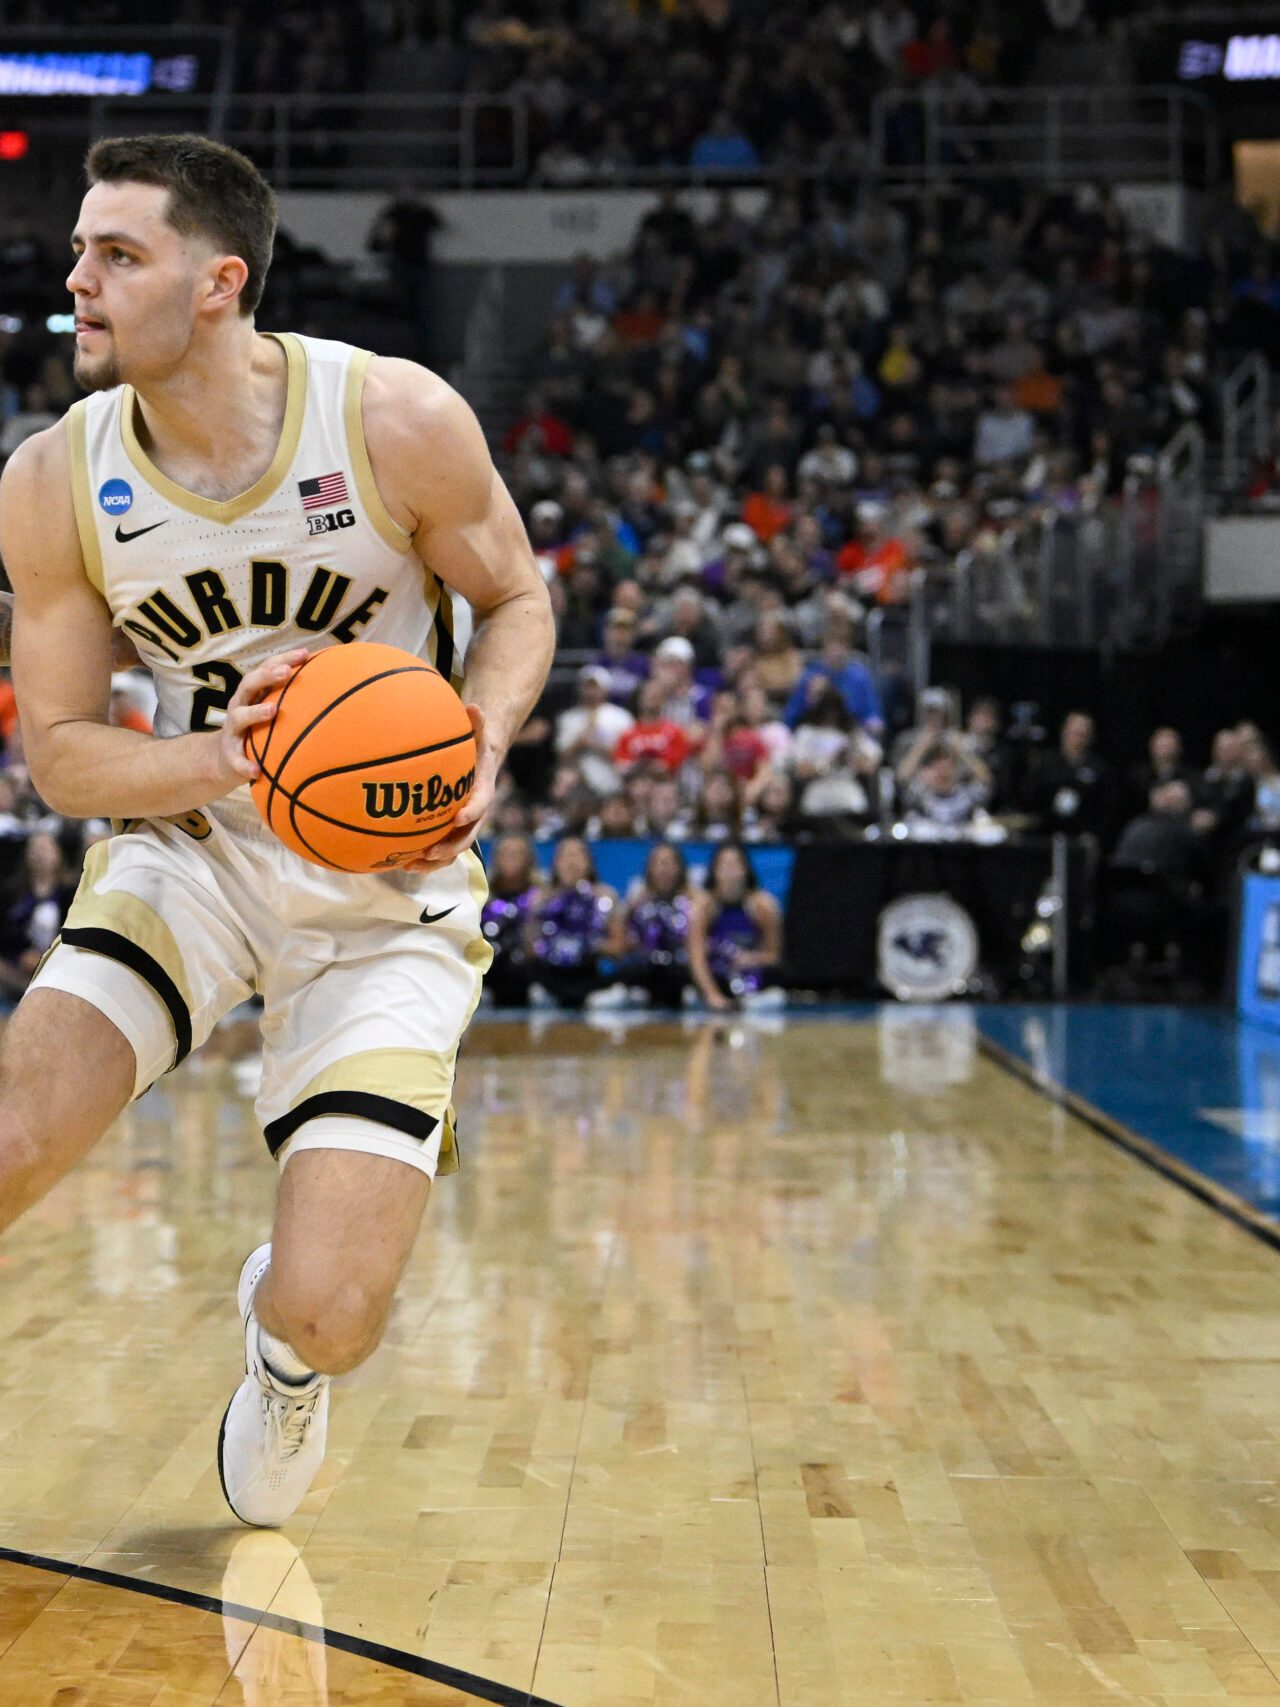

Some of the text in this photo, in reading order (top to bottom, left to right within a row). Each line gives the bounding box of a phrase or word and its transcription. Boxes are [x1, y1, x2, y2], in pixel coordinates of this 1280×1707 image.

[103, 495, 131, 507] NCAA
[121, 558, 391, 664] PURDUE
[361, 766, 476, 819] Wilson
